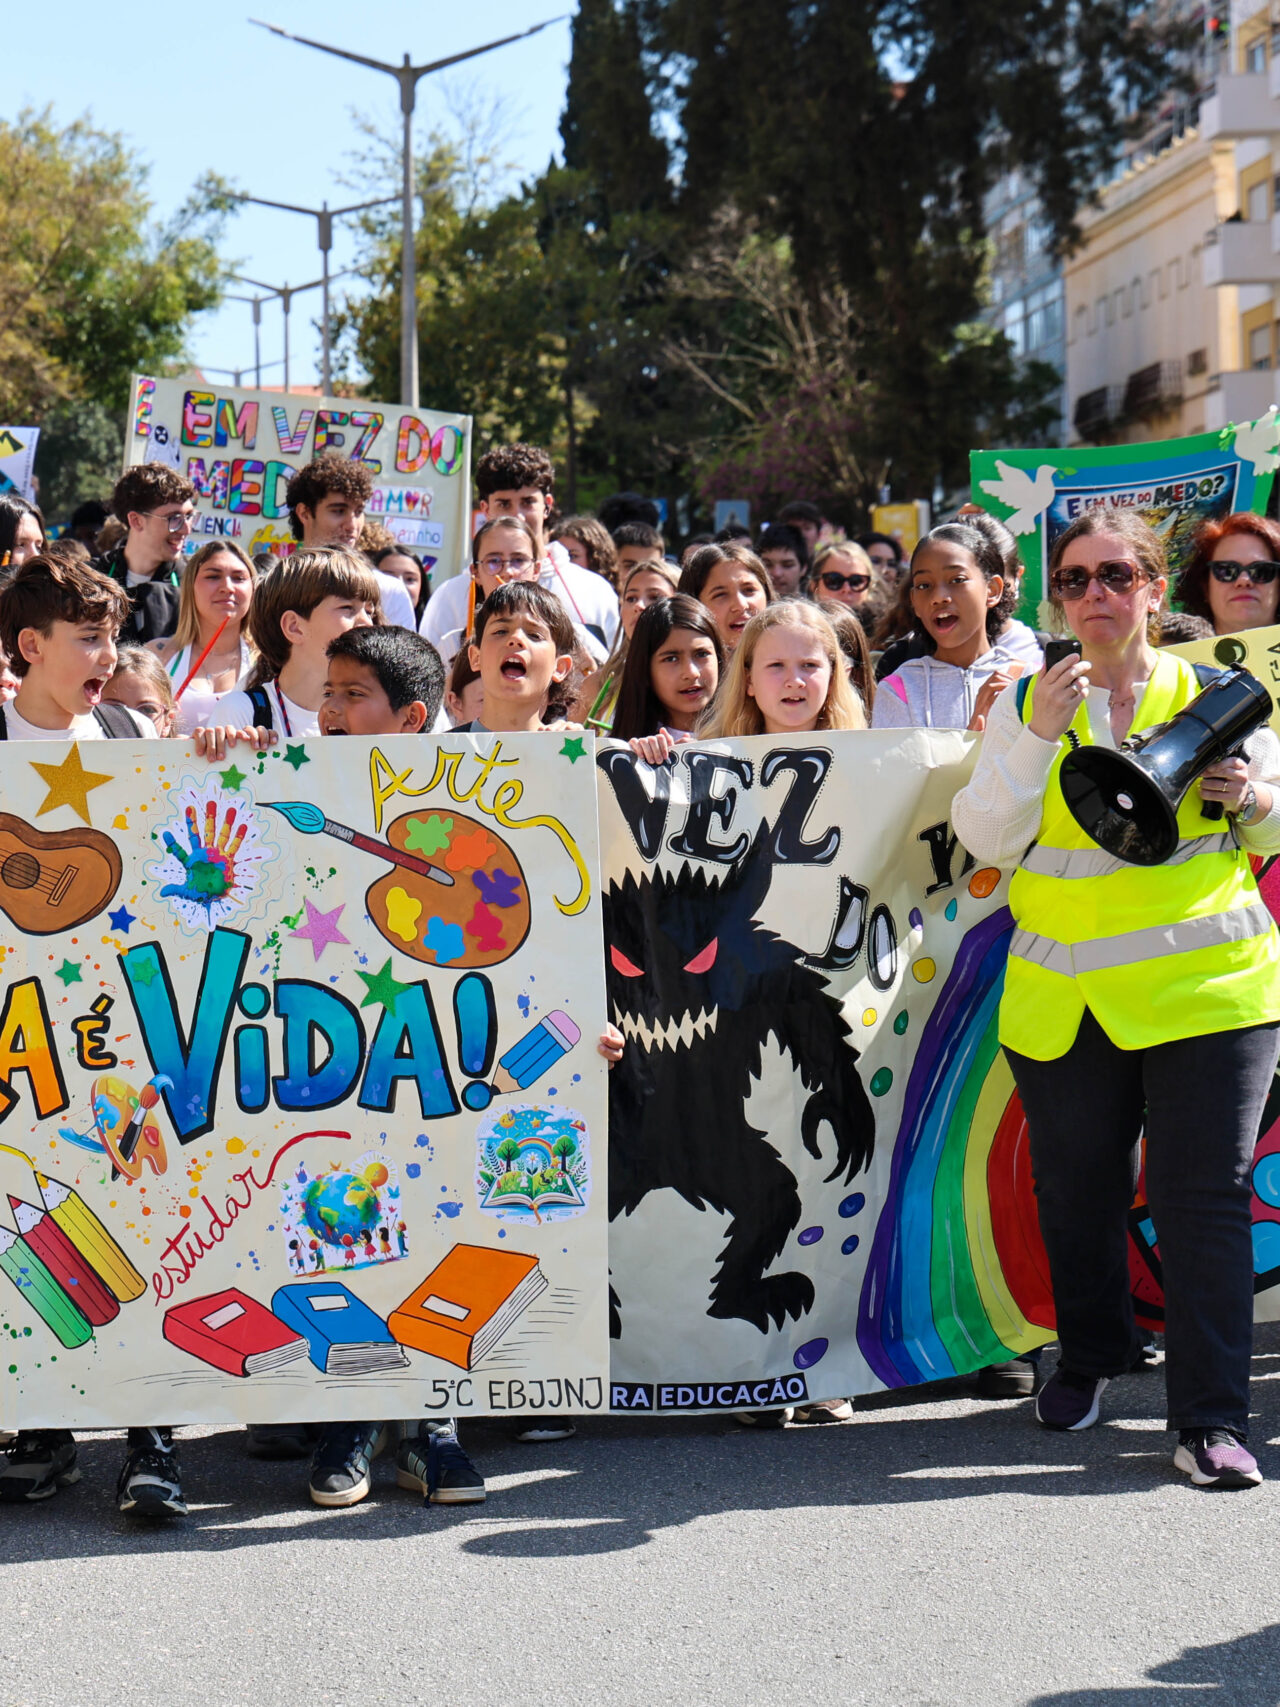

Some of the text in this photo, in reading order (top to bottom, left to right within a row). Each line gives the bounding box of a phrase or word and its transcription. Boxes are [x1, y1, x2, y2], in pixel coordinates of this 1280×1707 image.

[181, 390, 464, 476] EM VEZ DO
[187, 457, 298, 520] MED
[1110, 493, 1135, 508] VEZ
[1137, 492, 1152, 504] DO
[1154, 474, 1225, 506] MEDO?
[597, 747, 840, 866] VEZ
[804, 875, 898, 992] DO
[488, 1377, 603, 1410] EBJJNJ
[661, 1377, 805, 1407] EDUCAÇÃO
